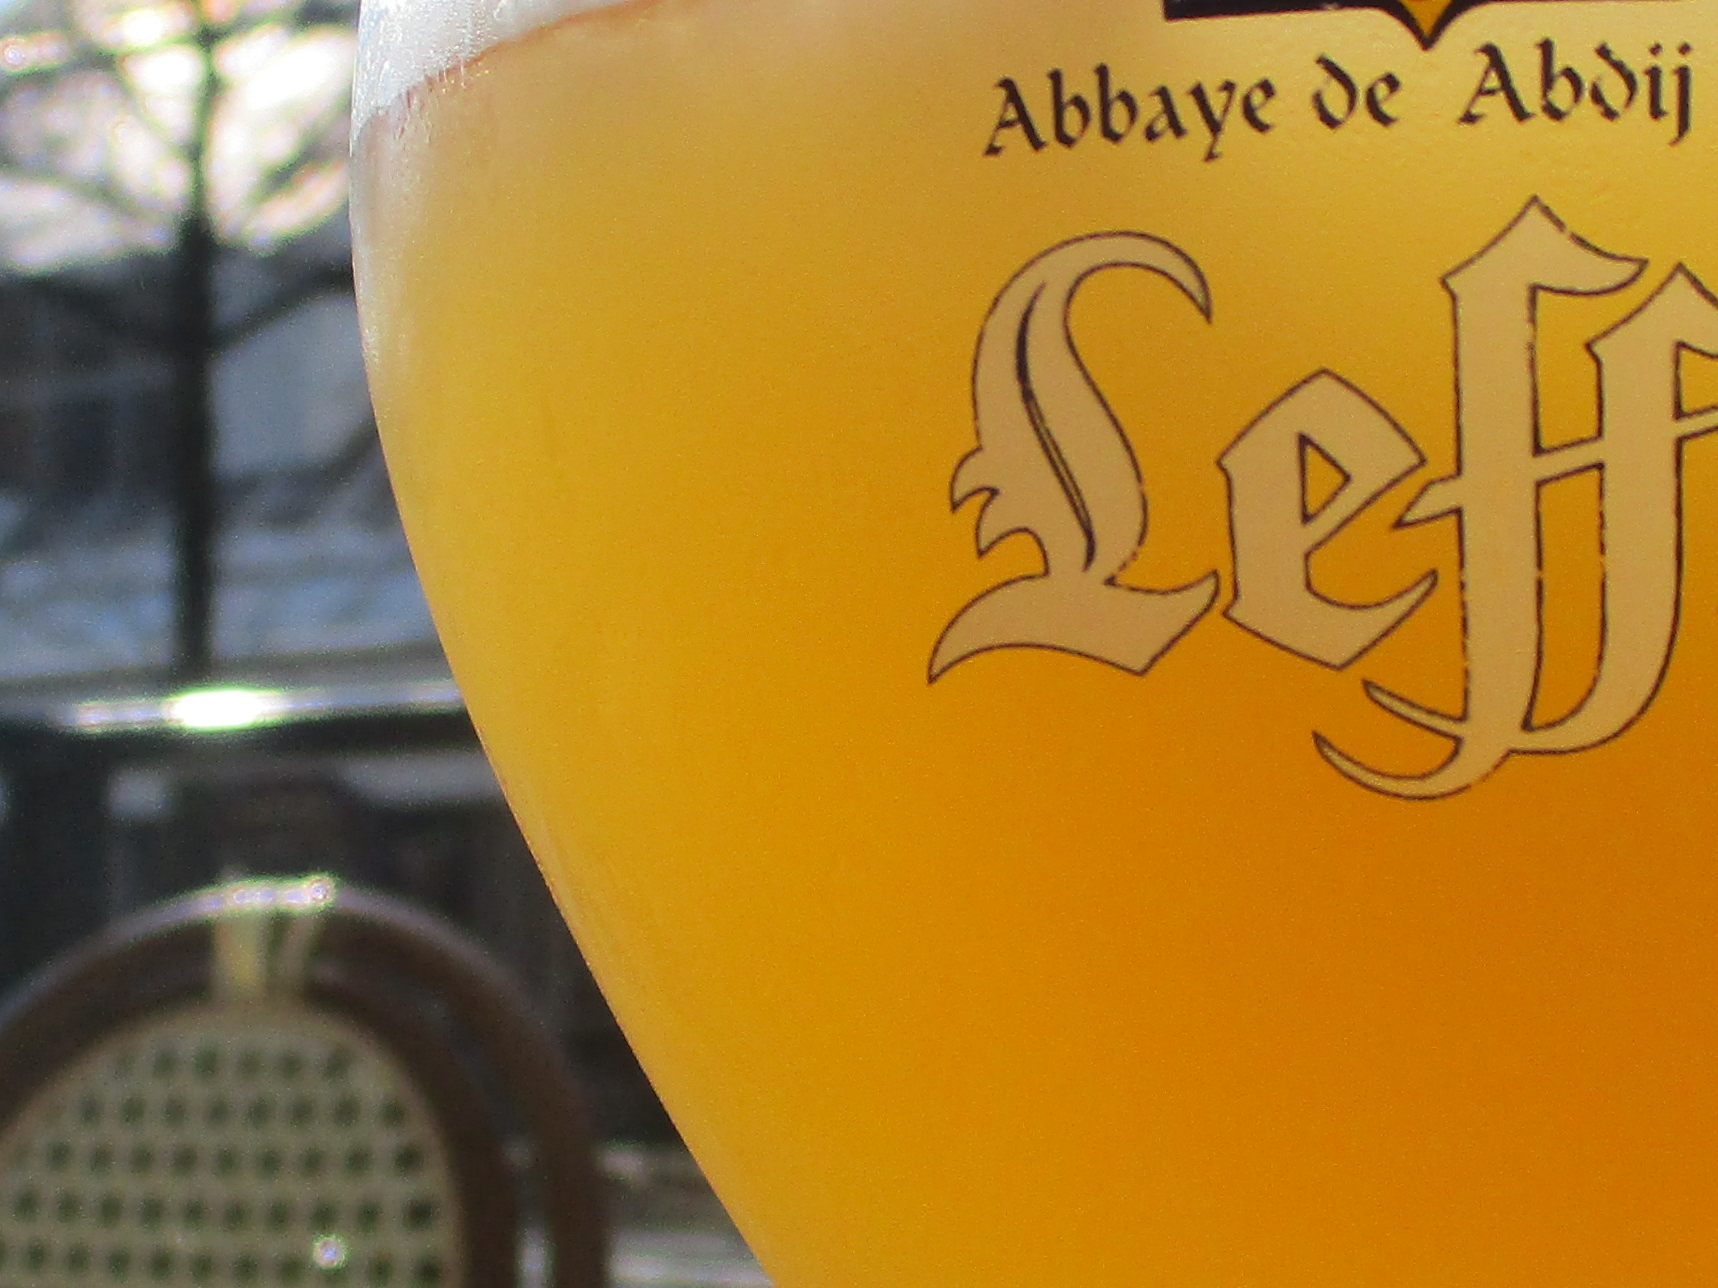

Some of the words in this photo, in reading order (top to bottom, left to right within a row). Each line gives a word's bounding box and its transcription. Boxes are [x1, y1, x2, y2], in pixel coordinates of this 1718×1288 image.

[983, 62, 1276, 160] Abbaye
[1311, 54, 1401, 129] de
[1457, 40, 1694, 144] Abdij
